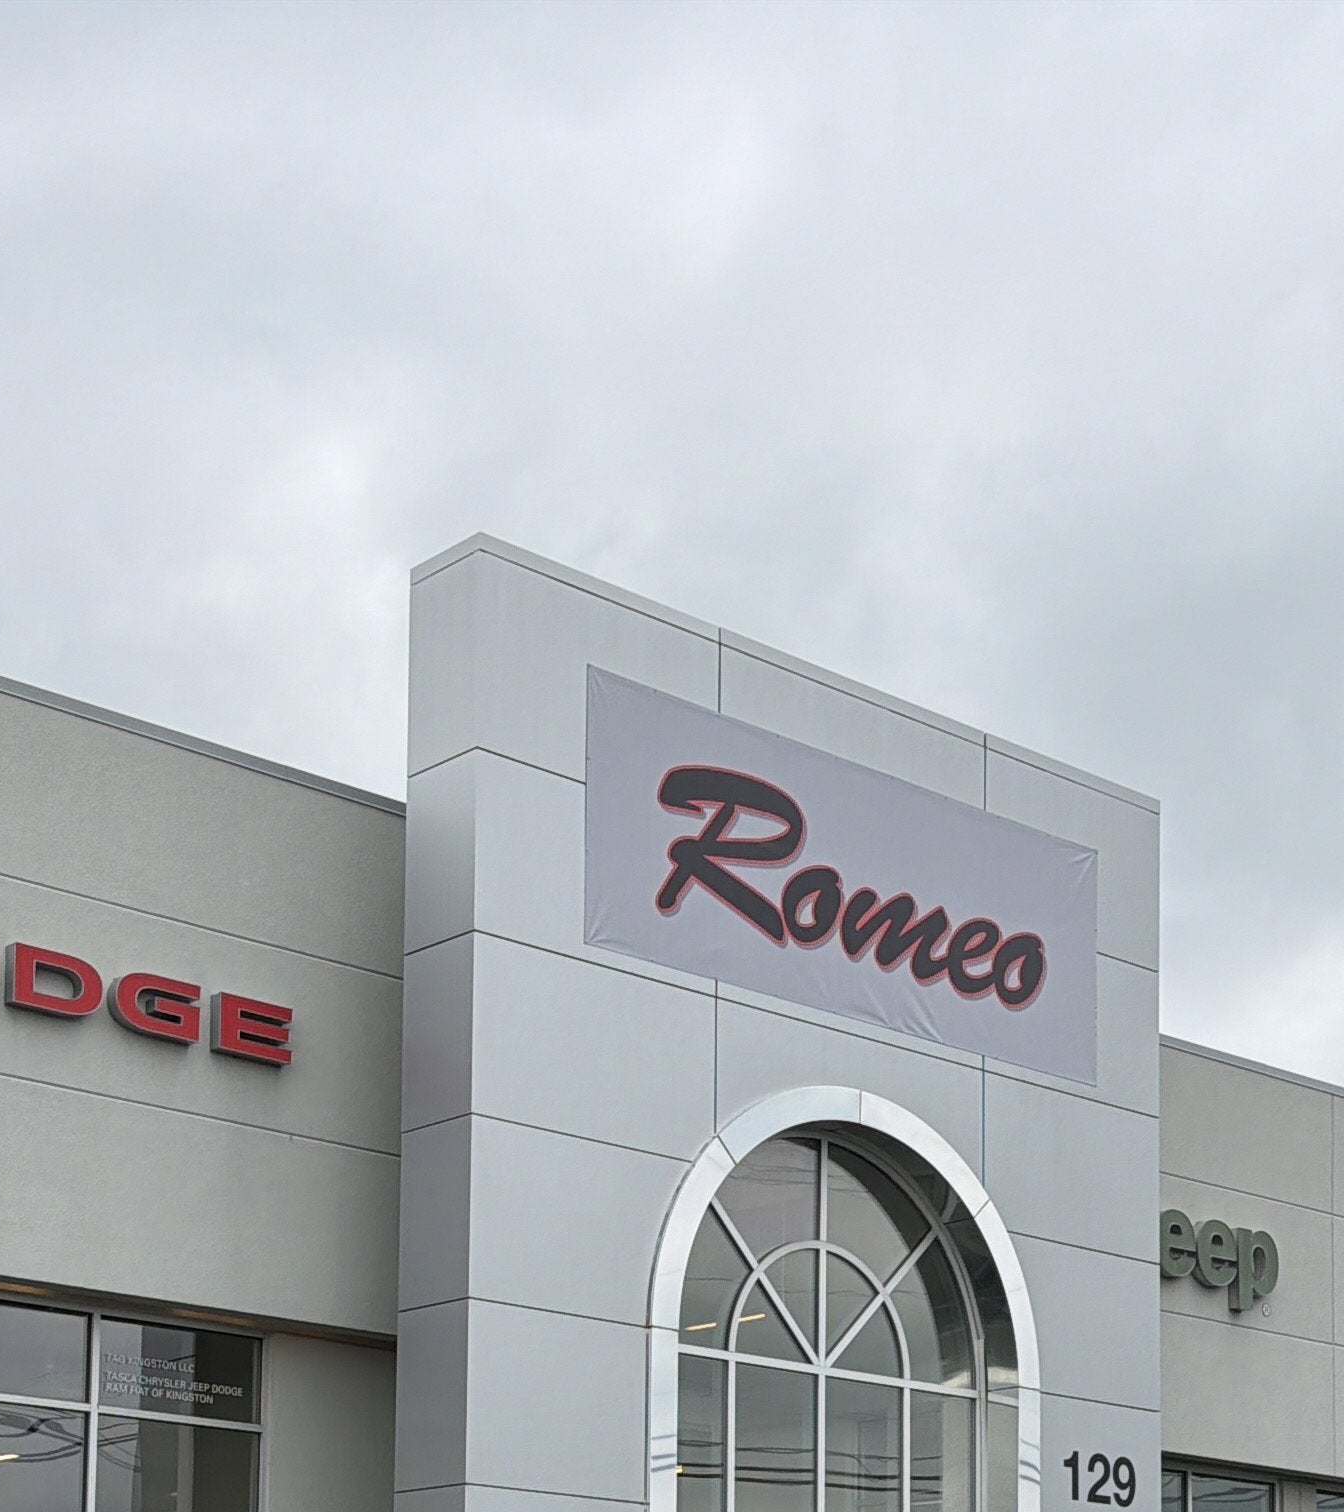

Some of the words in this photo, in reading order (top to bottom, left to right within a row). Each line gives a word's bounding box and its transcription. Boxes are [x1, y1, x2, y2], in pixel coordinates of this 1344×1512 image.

[657, 764, 1048, 1011] Romeo
[1160, 1209, 1280, 1313] eep
[106, 1370, 137, 1383] TASCA
[138, 1375, 186, 1389] CHRYSLER
[188, 1381, 210, 1392] JEEP
[211, 1384, 243, 1397] DODGE
[128, 1356, 176, 1371] KINGSTON
[178, 1363, 196, 1373] LLC
[105, 1383, 127, 1395] RAM
[151, 1388, 164, 1398] OF
[165, 1389, 214, 1404] KINGSTON
[1063, 1450, 1137, 1507] 129
